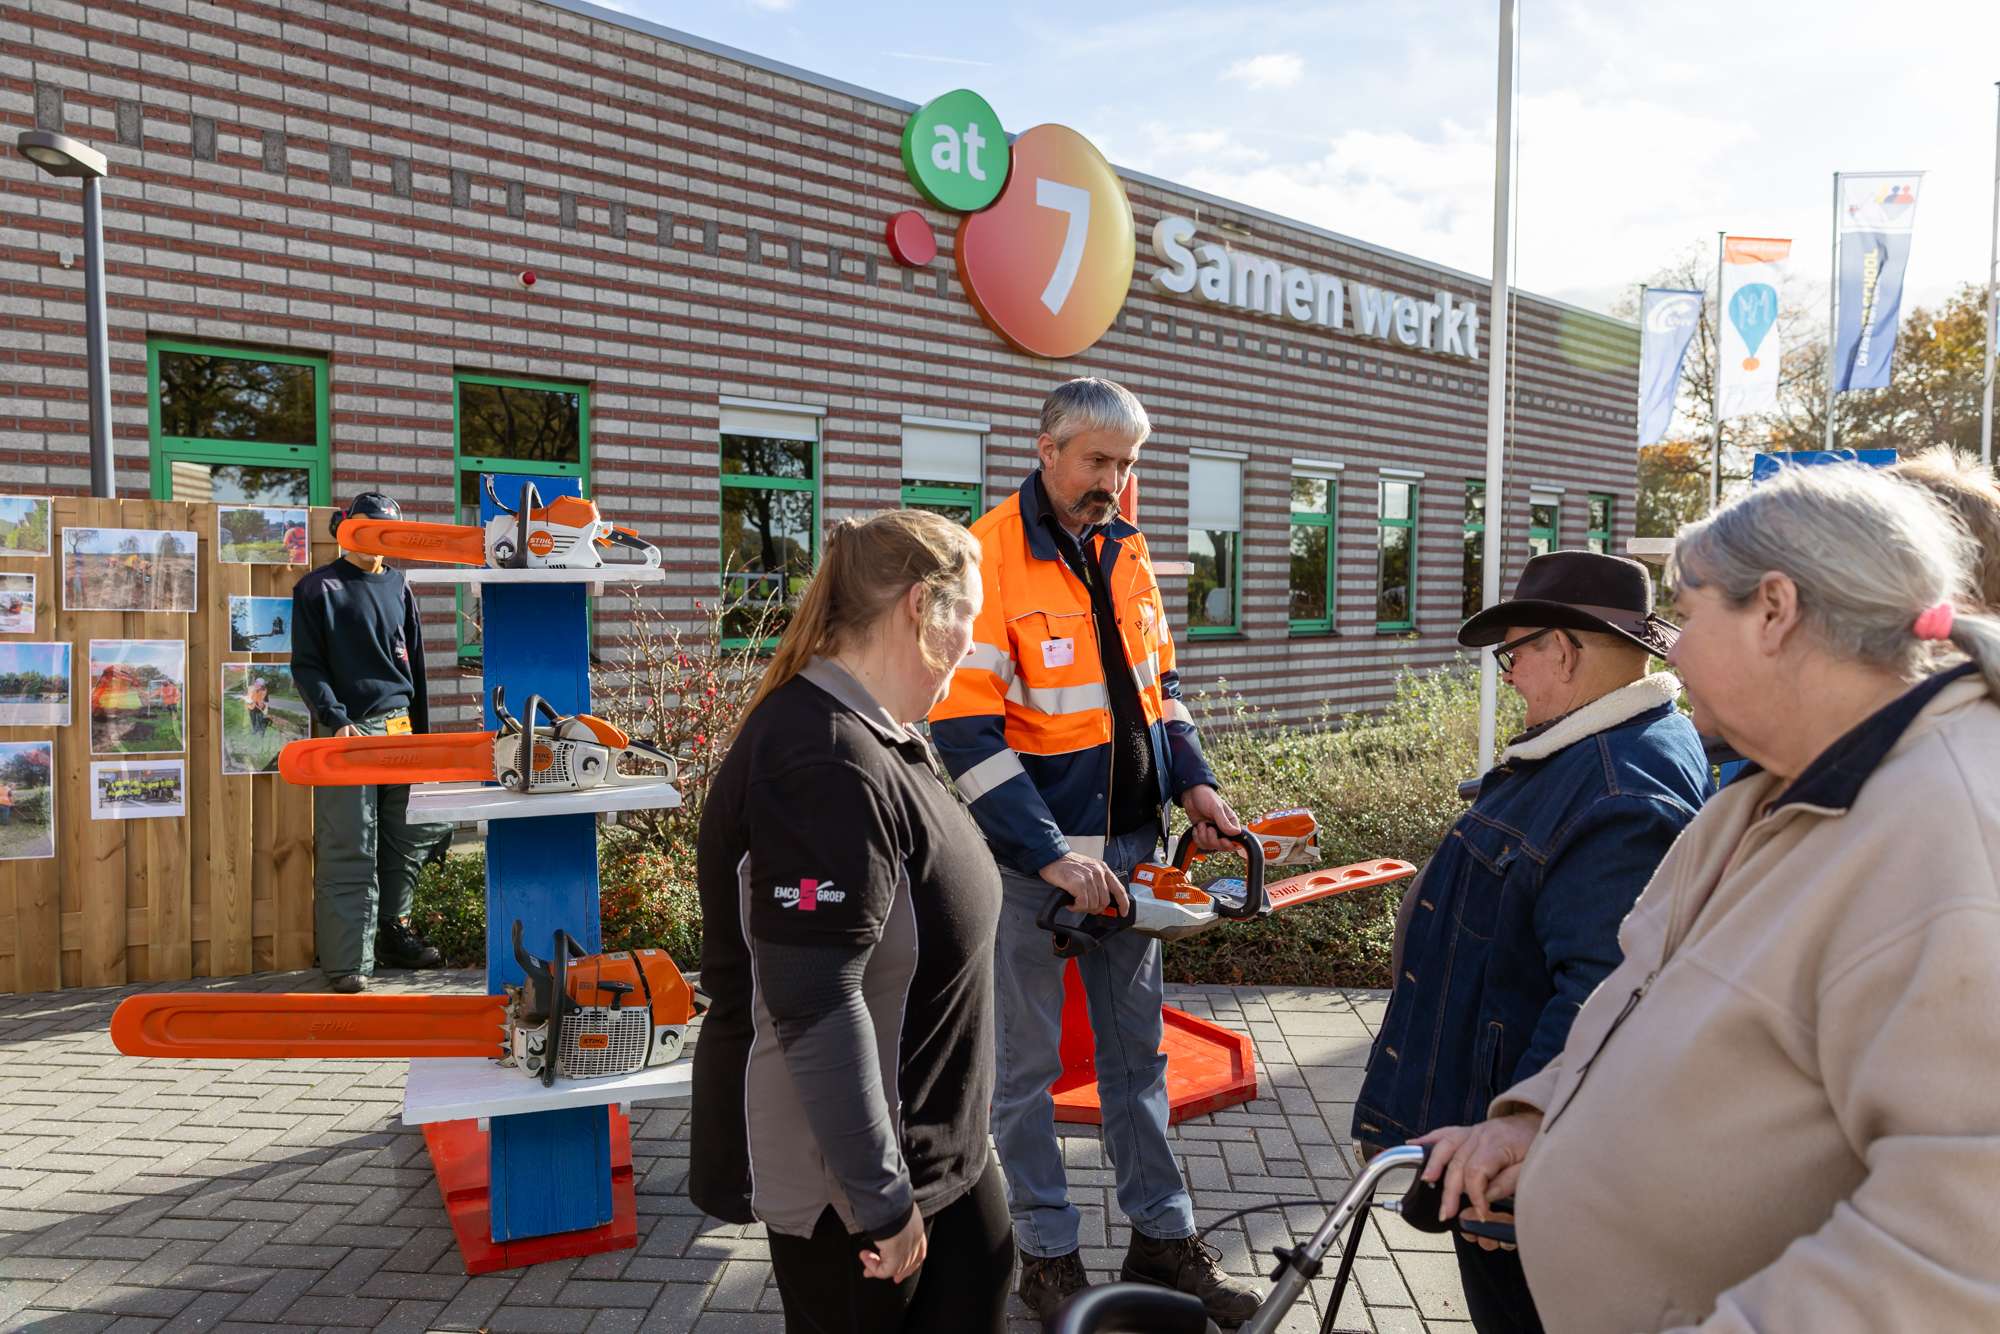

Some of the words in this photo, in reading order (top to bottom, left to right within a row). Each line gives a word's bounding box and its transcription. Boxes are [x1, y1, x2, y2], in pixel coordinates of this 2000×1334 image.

[931, 122, 987, 181] at
[1036, 176, 1091, 316] 7
[1151, 216, 1345, 329] Samen
[1350, 282, 1480, 360] werkt
[529, 537, 553, 545] STIHL
[774, 886, 800, 899] EMCO
[816, 890, 846, 903] GROEP
[309, 1021, 357, 1033] STIHL
[583, 1037, 606, 1045] STIHL
